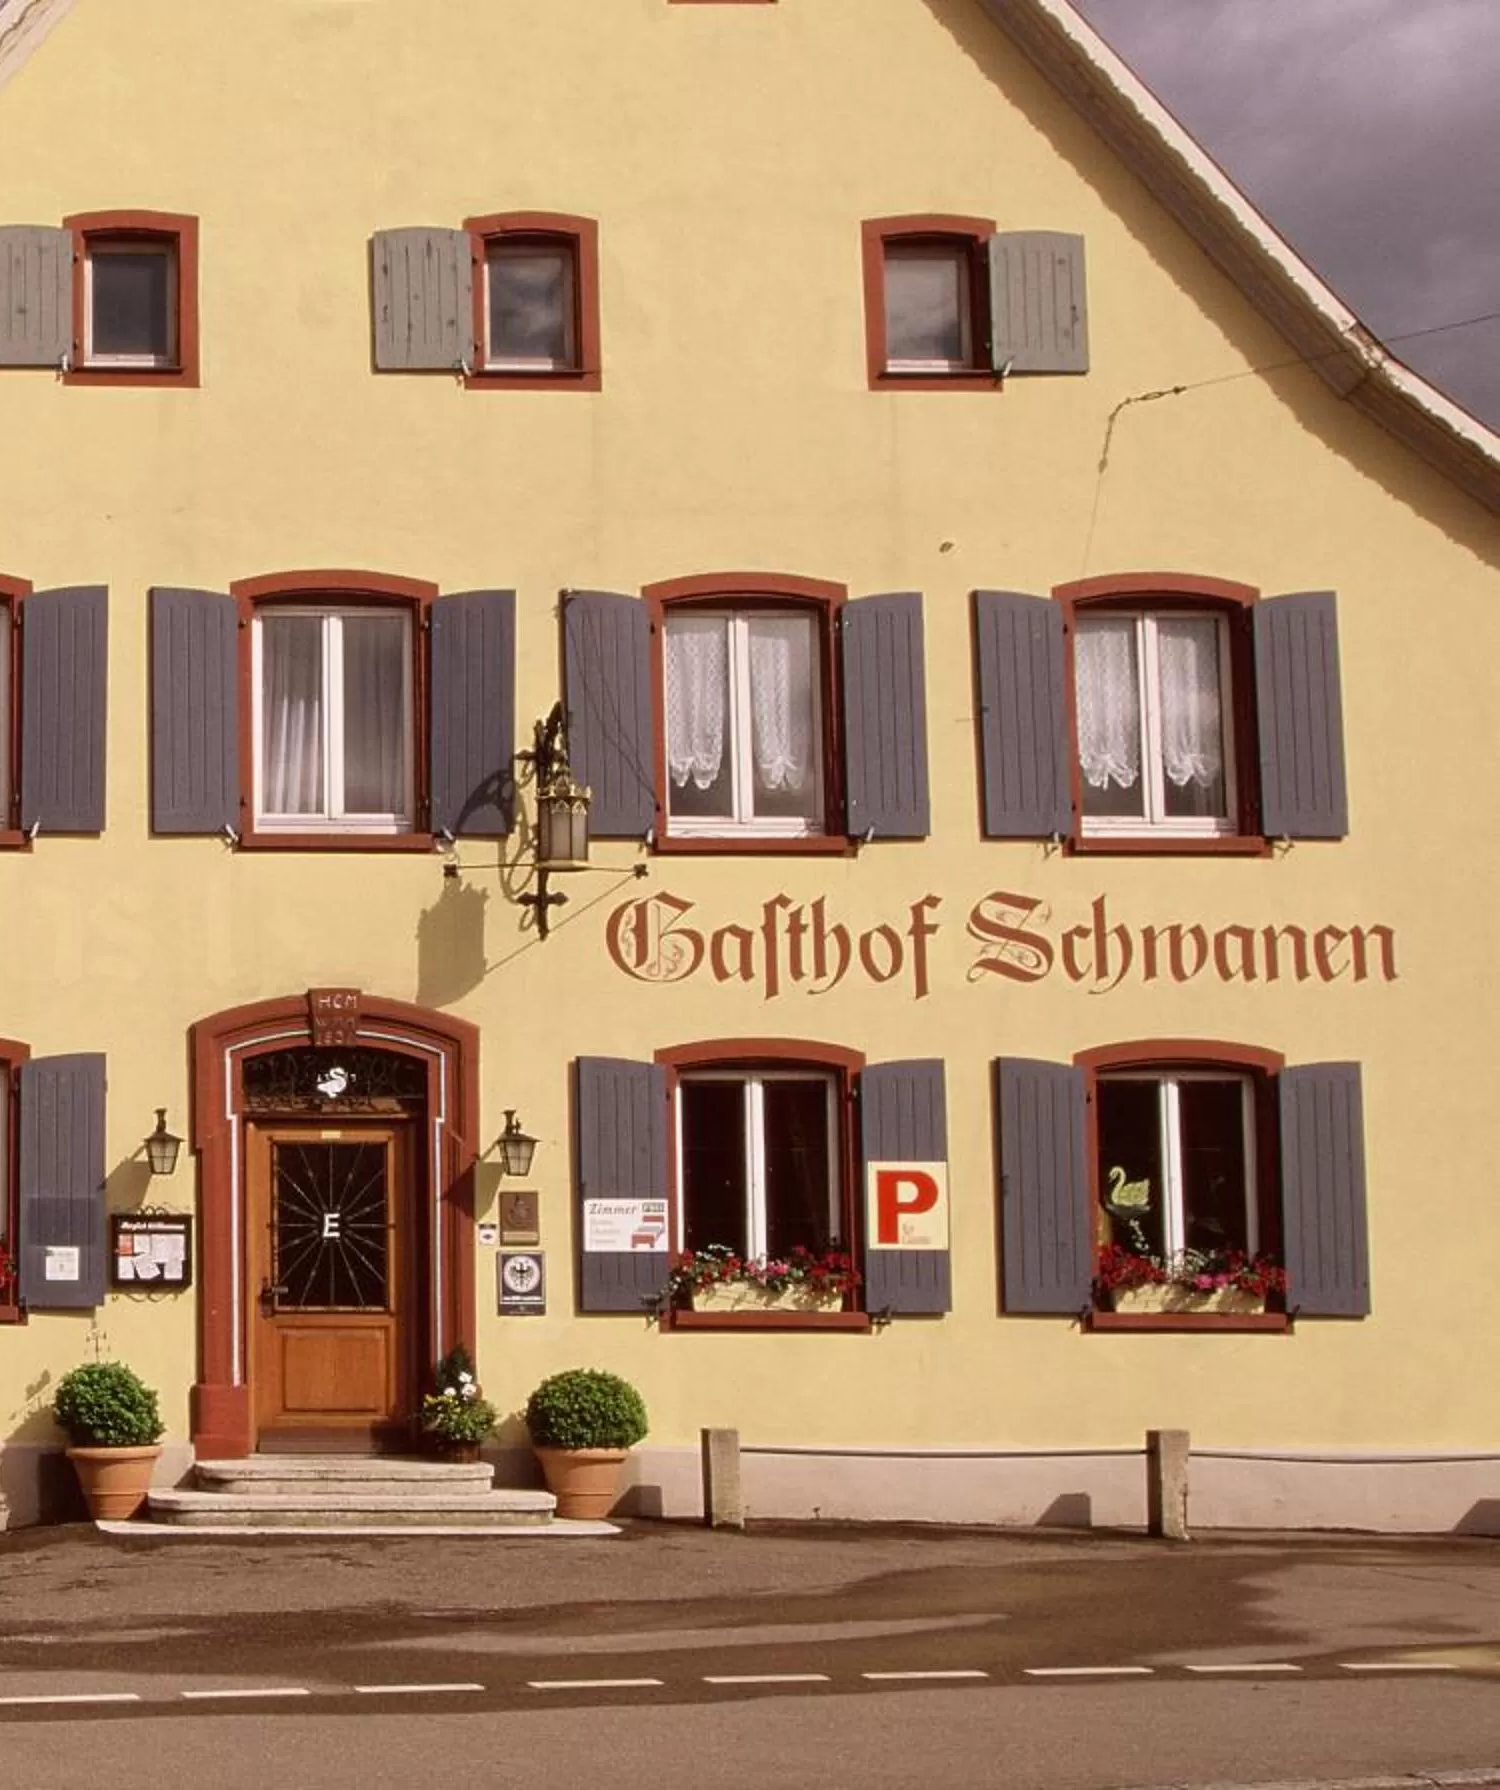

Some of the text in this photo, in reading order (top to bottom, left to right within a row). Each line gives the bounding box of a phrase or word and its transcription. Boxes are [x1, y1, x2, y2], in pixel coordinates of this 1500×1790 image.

[965, 890, 1398, 995] Schwanen
[323, 1213, 340, 1237] E
[588, 1203, 637, 1215] Zimmer
[876, 1170, 939, 1244] P
